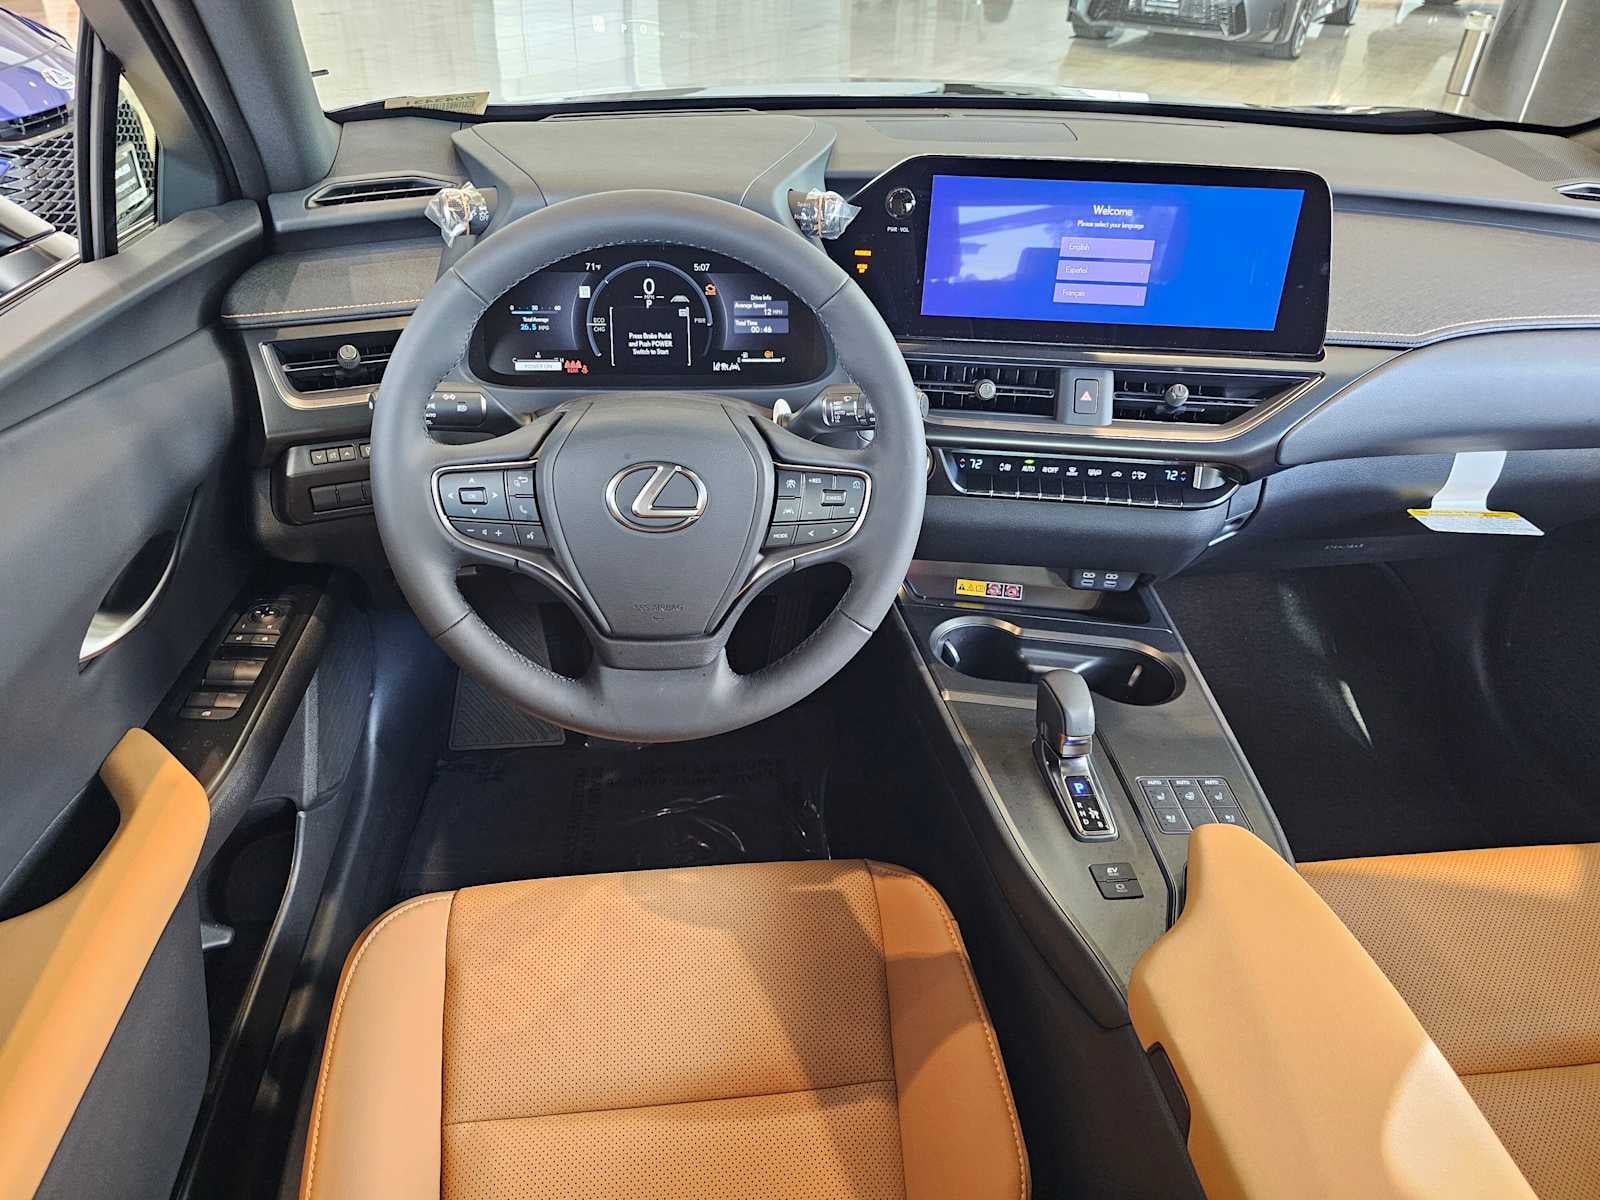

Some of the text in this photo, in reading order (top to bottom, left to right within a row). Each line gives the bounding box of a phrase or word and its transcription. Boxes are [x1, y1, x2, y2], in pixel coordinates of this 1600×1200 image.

[1093, 204, 1134, 217] Welcome
[1077, 219, 1094, 228] Please
[1094, 220, 1109, 228] select
[1109, 222, 1121, 230] your
[1069, 243, 1090, 252] English
[693, 263, 711, 272] 5:07
[643, 278, 656, 295] 0
[645, 300, 653, 309] P
[734, 302, 767, 310] Average Speed
[628, 332, 672, 340] Press Brake Pedal
[651, 340, 673, 348] POWER
[969, 459, 983, 470] 72
[1021, 465, 1036, 473] AUTO
[1047, 466, 1060, 474] OFF
[1165, 470, 1179, 481] 72
[1073, 782, 1084, 794] P
[1082, 818, 1090, 826] D
